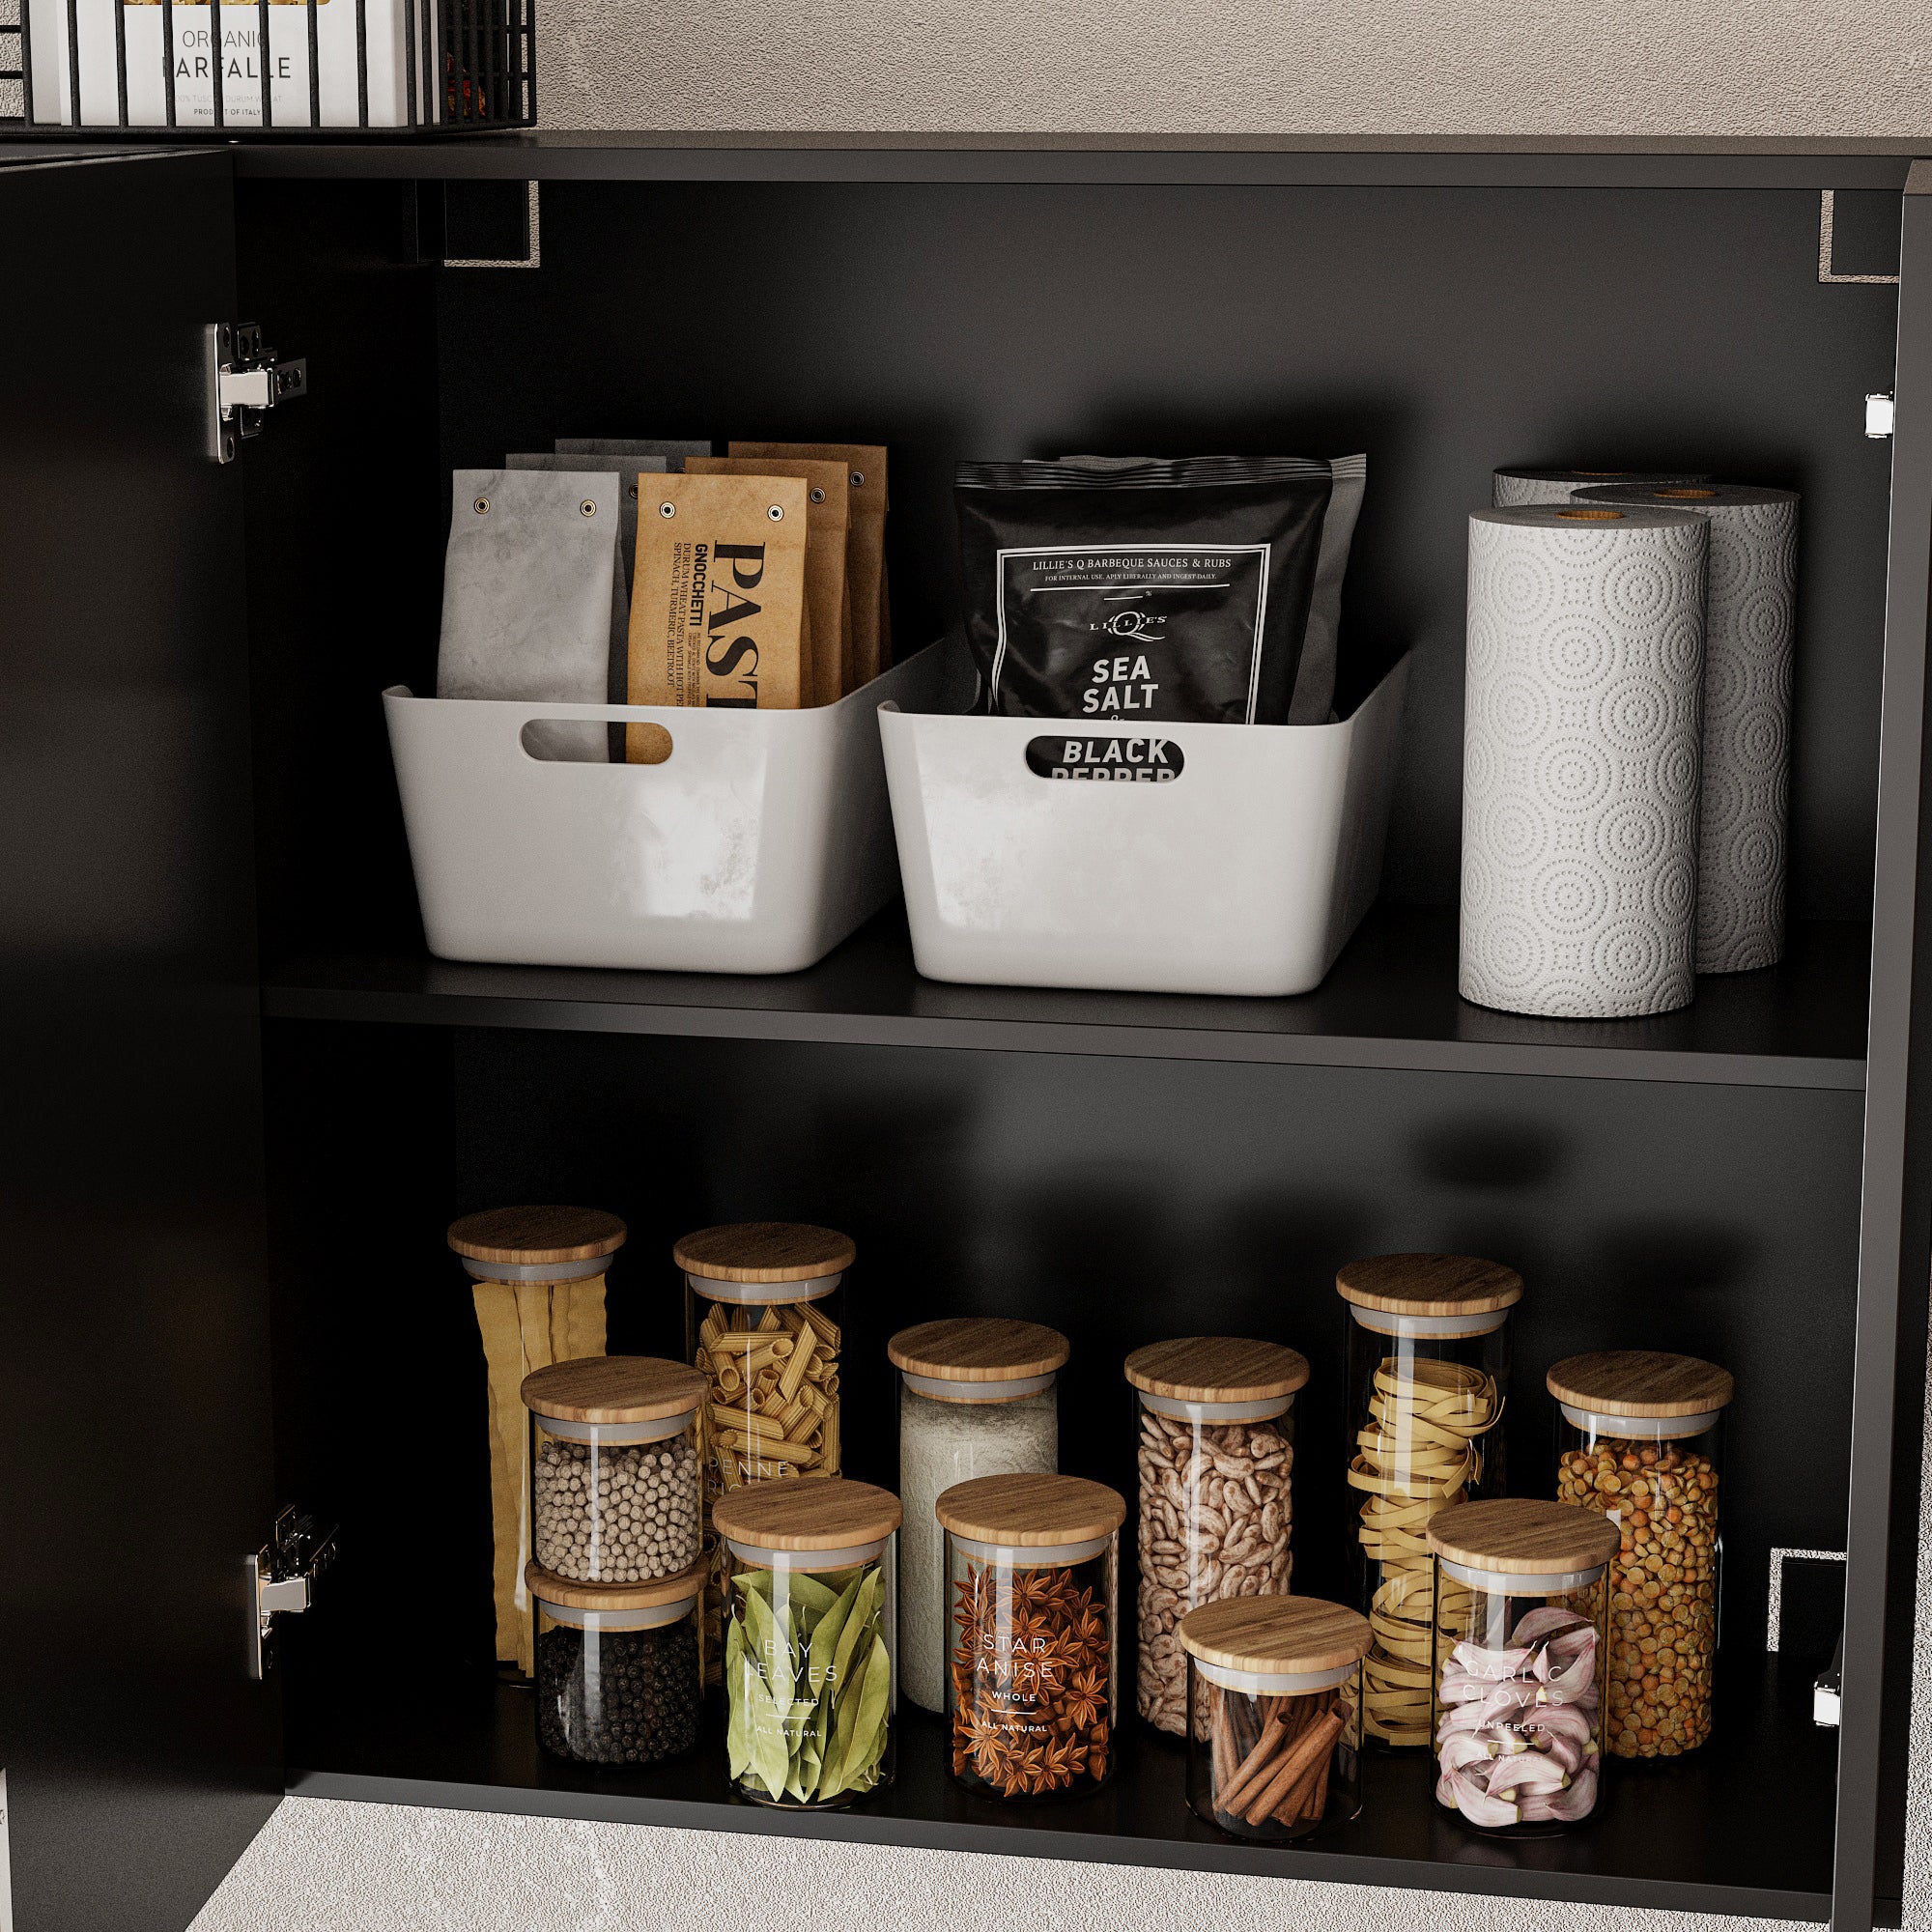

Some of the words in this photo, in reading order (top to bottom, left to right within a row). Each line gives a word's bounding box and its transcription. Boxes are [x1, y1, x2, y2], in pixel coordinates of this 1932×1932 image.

[183, 30, 262, 47] ORANI
[162, 56, 291, 78] ARALE
[671, 542, 682, 586] SPINACH,
[682, 543, 692, 580] DURUM
[1033, 560, 1074, 571] LILLIE'S
[1076, 559, 1085, 571] Q
[1087, 558, 1145, 569] BARBEQUE
[1147, 557, 1189, 568] SAUCES
[1191, 558, 1202, 568] &
[1204, 558, 1232, 568] RUBS
[690, 544, 708, 626] GNOCCHETTI
[678, 581, 688, 615] WHEAT
[668, 587, 679, 639] TURMERIC,
[676, 616, 686, 644] PASTA
[667, 639, 675, 687] BEETROOT
[675, 647, 684, 671] WITH
[1092, 655, 1151, 684] SEA
[675, 673, 684, 692] HOT
[1082, 684, 1159, 714] SALT
[1063, 738, 1169, 764] BLACK
[708, 1457, 789, 1477] PENNE
[764, 1639, 813, 1659] BAY
[983, 1634, 1046, 1654] STAR
[976, 1658, 1054, 1678] ANISE
[1465, 1660, 1562, 1683] GARLC
[758, 1693, 819, 1707] SELECTED
[991, 1690, 1037, 1702] WHOLE
[1463, 1684, 1564, 1708] CLOVES
[756, 1726, 773, 1735] ALL
[777, 1729, 822, 1738] NATURAL
[981, 1720, 998, 1730] ALL
[1002, 1723, 1048, 1732] NATURAL
[1479, 1720, 1546, 1732] UNPEELED
